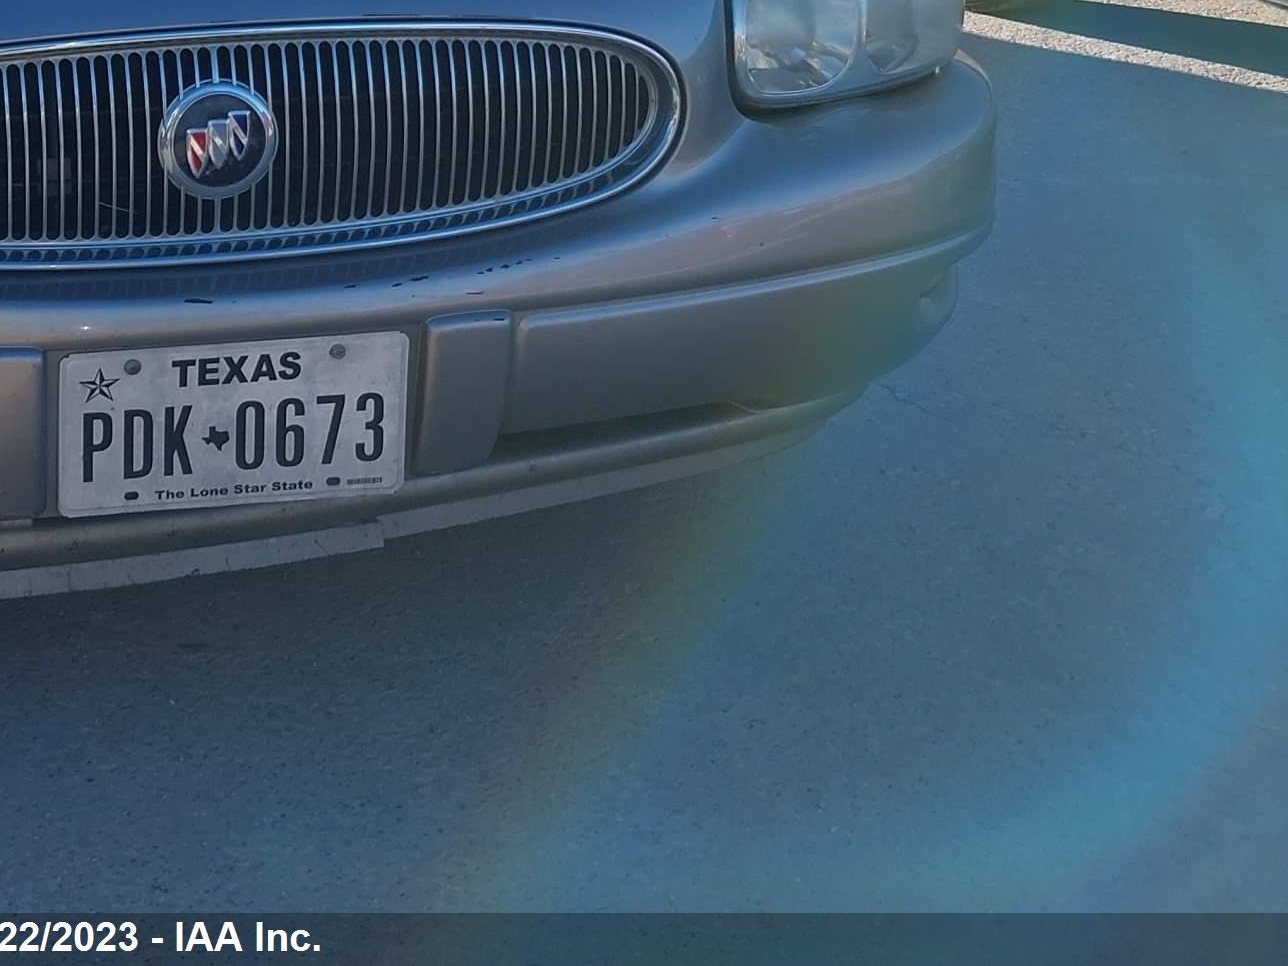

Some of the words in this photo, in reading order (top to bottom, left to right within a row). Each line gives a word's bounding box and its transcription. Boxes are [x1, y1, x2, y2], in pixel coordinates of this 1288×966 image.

[172, 351, 302, 388] TEXAS
[82, 404, 193, 483] PDK
[235, 392, 385, 471] 0673
[154, 488, 185, 501] The
[190, 485, 229, 498] Lone
[233, 482, 267, 495] Star
[271, 479, 313, 492] State
